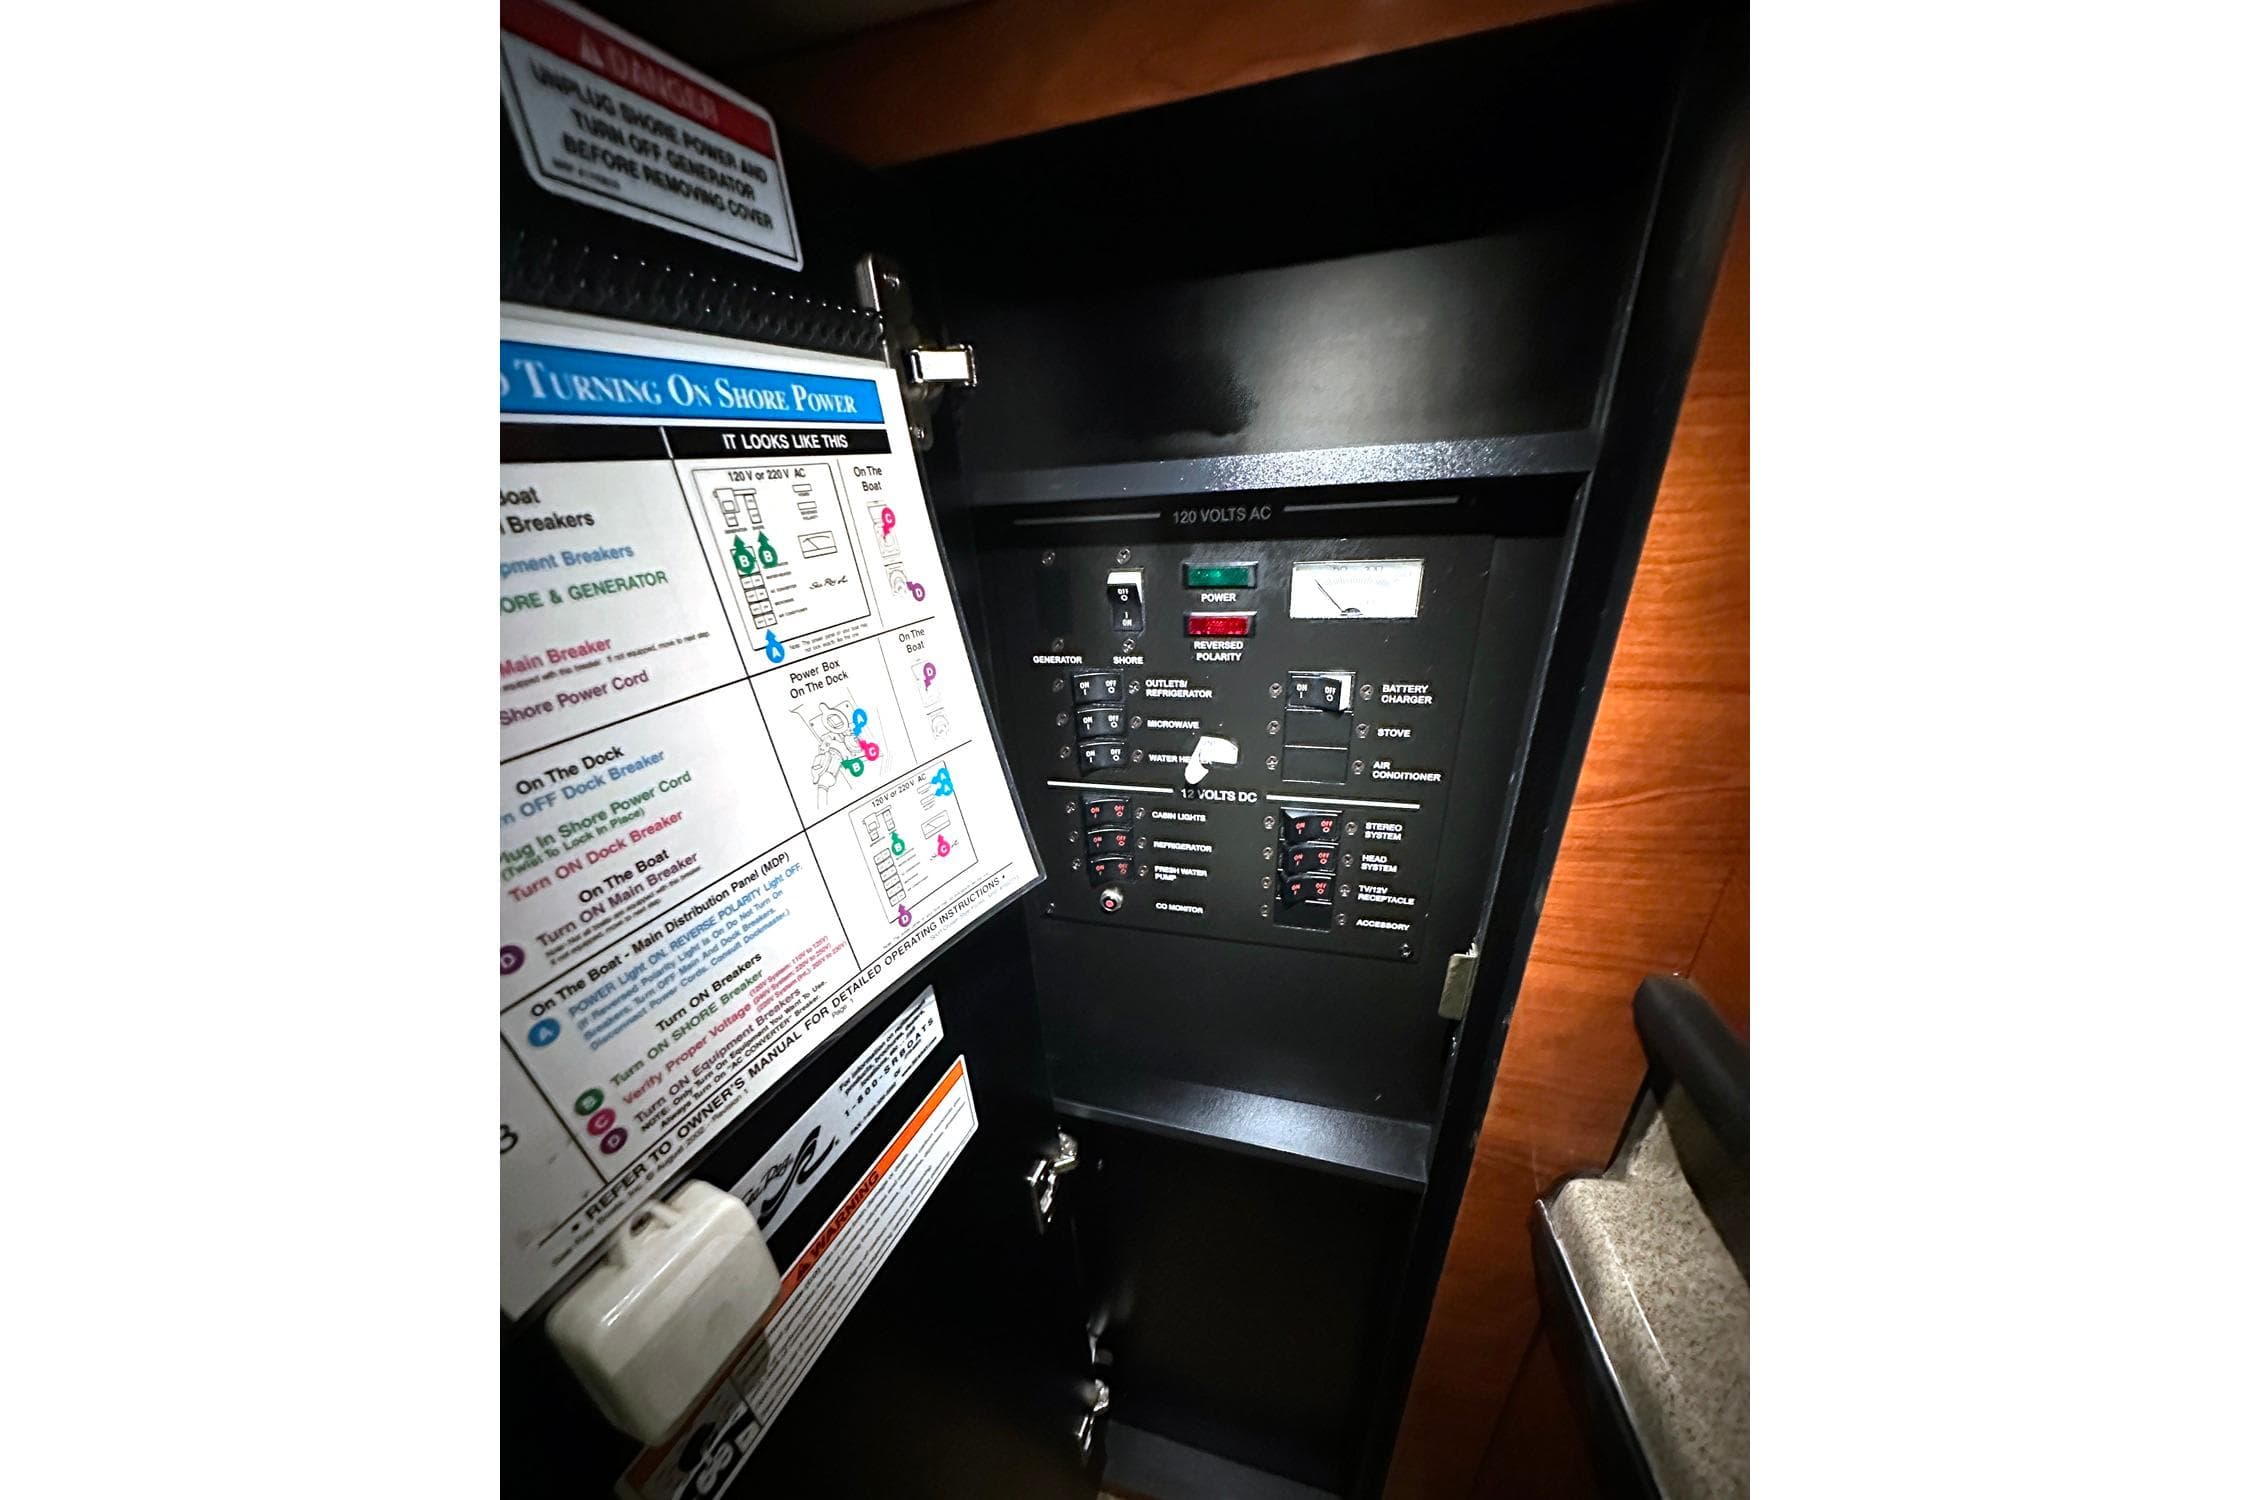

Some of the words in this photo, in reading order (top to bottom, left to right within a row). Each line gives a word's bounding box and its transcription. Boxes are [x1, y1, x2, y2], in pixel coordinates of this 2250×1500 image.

[619, 102, 679, 145] SHORE
[682, 130, 738, 168] POWER
[740, 158, 769, 184] AND
[570, 106, 625, 146] TURN
[629, 133, 662, 160] OFF
[665, 149, 756, 201] GENERATOR
[562, 131, 640, 180] BEFORE
[642, 164, 726, 212] REMOVING
[727, 198, 773, 230] COVER
[514, 358, 662, 406] TURNING
[667, 373, 711, 408] ON
[715, 377, 790, 411] SHORE
[791, 383, 858, 414] POWER
[722, 434, 737, 450] IT
[744, 433, 790, 450] LOOKS
[793, 434, 822, 449] LIKE
[826, 433, 849, 449] THIS
[728, 470, 745, 482] 120
[766, 469, 781, 480] 220
[794, 467, 807, 478] AC
[853, 466, 867, 477] On
[867, 465, 883, 476] The
[862, 480, 883, 492] Boat
[506, 512, 596, 534] Breakers
[1172, 510, 1198, 525] 120
[1199, 507, 1248, 523] VOLTS
[1249, 506, 1272, 521] AC
[561, 545, 635, 567] Breakers
[568, 571, 670, 602] GENERATOR
[1200, 592, 1237, 603] POWER
[898, 631, 911, 643] On
[910, 628, 925, 640] The
[906, 641, 926, 654] Boat
[1193, 640, 1244, 651] REVERSED
[500, 655, 544, 679] Main
[546, 637, 612, 664] Breaker
[1032, 655, 1083, 665] GENERATOR
[1112, 655, 1144, 665] SHORE
[1196, 651, 1242, 662] POLARITY
[789, 663, 819, 684] Power
[822, 659, 841, 675] Box
[790, 685, 807, 699] On
[807, 680, 824, 695] The
[825, 670, 849, 687] Dock
[1145, 679, 1188, 688] OUTLETS/
[1382, 684, 1429, 695] BATTERY
[500, 701, 555, 726] Shore
[556, 682, 609, 709] Power
[611, 670, 650, 691] Cord
[1145, 688, 1213, 698] REFRIGERATOR
[1380, 694, 1433, 705] CHARGER
[1146, 720, 1201, 729] MICROWAVE
[1376, 728, 1412, 738] STOVE
[1148, 754, 1178, 763] WATER
[1373, 761, 1391, 770] AIR
[516, 778, 546, 796] On
[544, 764, 580, 783] The
[581, 746, 625, 770] Dock
[1372, 769, 1442, 782] CONDITIONER
[519, 791, 557, 818] OFF
[561, 775, 607, 800] Dock
[607, 750, 666, 781] Breaker
[1181, 788, 1194, 799] 12
[1197, 789, 1236, 802] VOLTS
[1238, 791, 1258, 803] DC
[558, 809, 608, 838] Shore
[609, 787, 656, 815] Power
[658, 770, 693, 793] Cord
[1151, 811, 1177, 820] CABIN
[1178, 812, 1207, 822] LIGHTS
[1365, 821, 1403, 833] STEREO
[562, 831, 595, 852] Lock
[1364, 831, 1402, 841] SYSTEM
[1153, 841, 1213, 853] REFRIGERATOR
[508, 875, 553, 902] Turn
[555, 859, 584, 880] ON
[586, 839, 627, 865] Dock
[629, 810, 684, 844] Breaker
[1361, 854, 1388, 864] HEAD
[1154, 865, 1180, 876] FRESH
[1180, 867, 1208, 878] WATER
[1360, 863, 1398, 873] SYSTEM
[579, 885, 604, 903] On
[602, 868, 634, 889] The
[635, 849, 671, 874] Boat
[1154, 873, 1177, 881] PUMP
[1358, 885, 1389, 894] TV/12V
[537, 920, 577, 947] Turn
[579, 905, 606, 924] ON
[608, 884, 645, 908] Main
[646, 852, 698, 886] Breaker
[1357, 893, 1416, 906] RECEPTACLE
[1155, 901, 1168, 911] CO
[1168, 903, 1204, 915] MONITOR
[1355, 919, 1411, 932] ACCESSORY
[531, 999, 557, 1017] On
[555, 980, 586, 1000] The
[587, 955, 623, 981] Boat
[631, 930, 664, 954] Main
[665, 889, 731, 934] Distribution
[731, 869, 760, 892] Panel
[760, 851, 790, 877] (MDP)
[568, 982, 616, 1017] POWER
[618, 963, 648, 985] Light
[669, 915, 718, 952] REVERSE
[718, 887, 762, 920] POLARITY
[763, 874, 785, 892] Light
[655, 1008, 688, 1032] Turn
[689, 988, 710, 1008] ON
[711, 953, 762, 992] Breakers
[610, 1060, 645, 1087] Turn
[647, 1039, 670, 1060] ON
[671, 1002, 719, 1042] SHORE
[719, 970, 763, 1006] Breaker
[585, 1163, 648, 1219] REFER
[648, 1140, 673, 1162] TO
[677, 1077, 746, 1139] OWNER'S
[748, 1031, 803, 1078] MANUAL
[804, 1006, 830, 1031] FOR
[831, 964, 882, 1008] DETAILED
[884, 922, 938, 966] OPERATING
[938, 876, 1001, 925] INSTRUCTIONS
[622, 1071, 663, 1105] Verify
[665, 1035, 708, 1073] Proper
[708, 1003, 752, 1038] Voltage
[634, 1097, 667, 1122] Turn
[668, 1075, 690, 1096] ON
[691, 1024, 755, 1077] Equipment
[755, 988, 801, 1026] Breakers
[672, 1088, 694, 1106] Only
[694, 1070, 714, 1086] Turn
[715, 1059, 729, 1070] On
[729, 1026, 770, 1059] Equipment
[692, 1083, 712, 1101] Turn
[713, 1071, 727, 1084] On
[811, 1170, 880, 1258] WARNING
